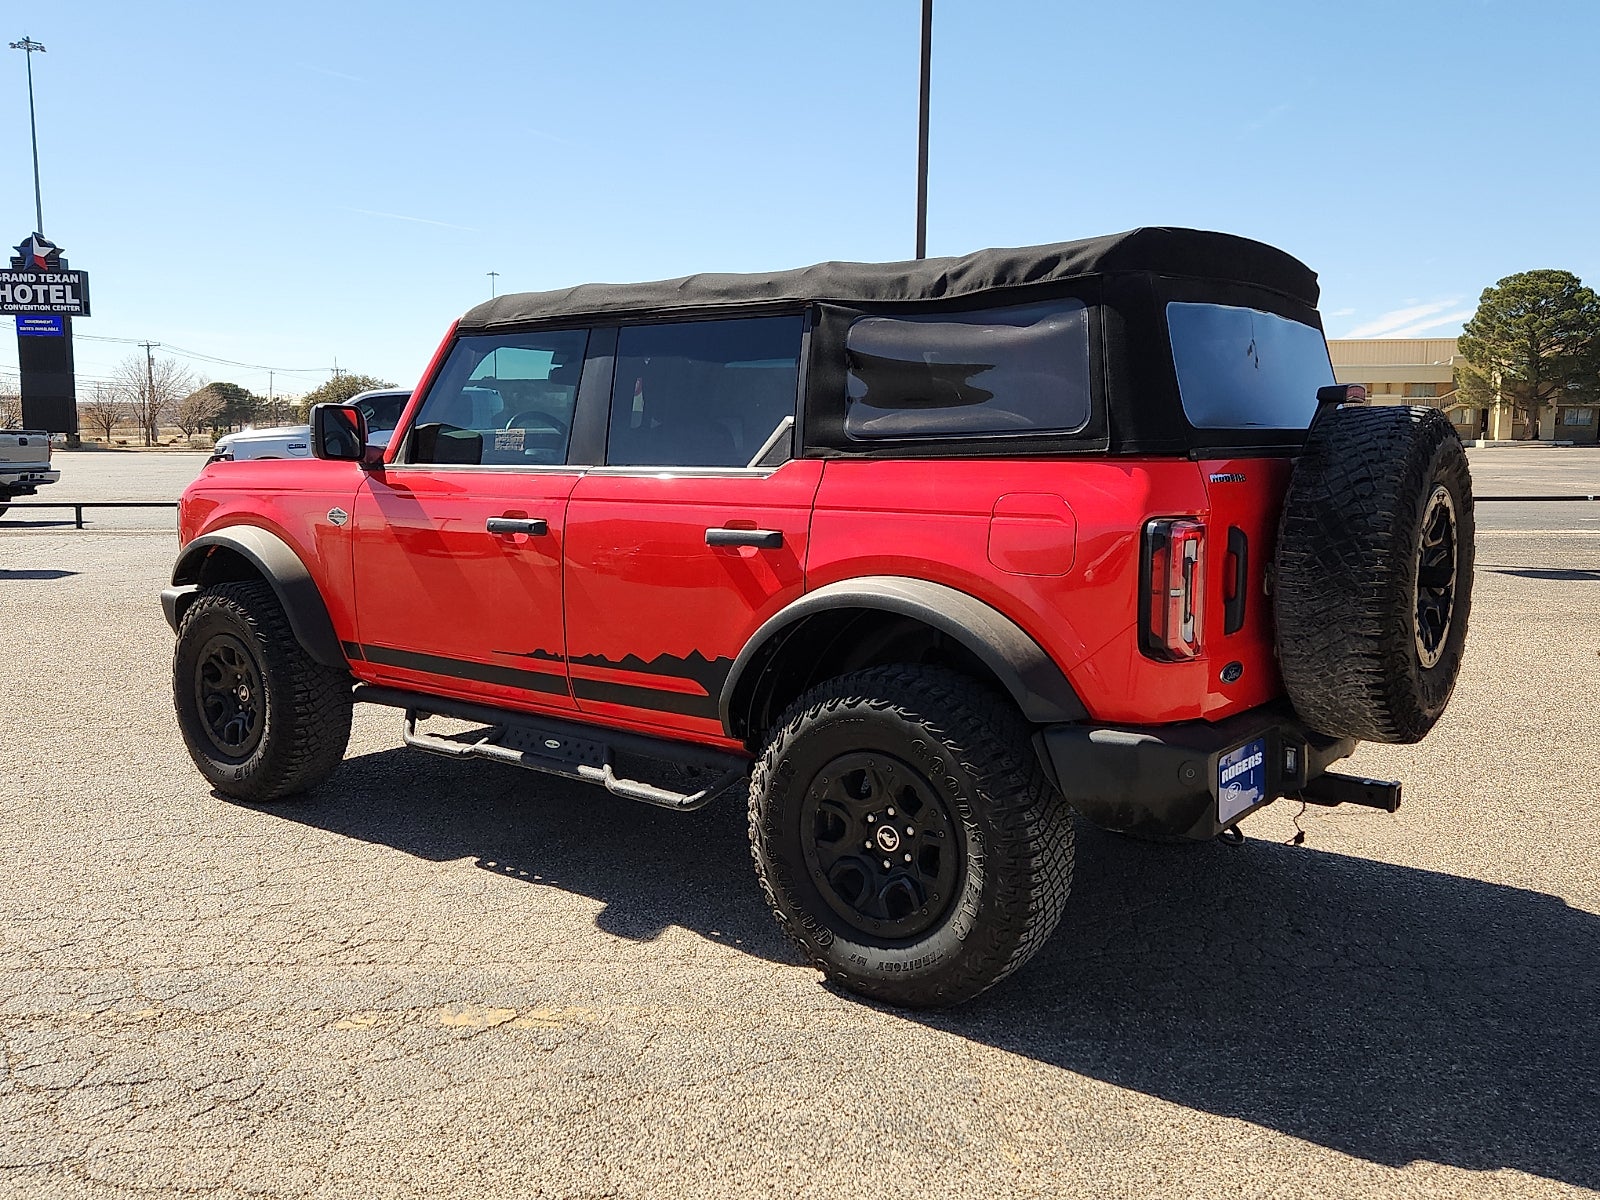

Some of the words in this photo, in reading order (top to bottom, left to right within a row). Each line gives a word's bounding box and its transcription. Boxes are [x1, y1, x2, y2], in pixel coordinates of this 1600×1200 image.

[0, 272, 36, 283] RAND
[38, 273, 79, 283] TEXAN
[0, 283, 80, 304] HOTEL
[4, 303, 51, 311] CONVENTION
[52, 304, 80, 312] CENTER
[1221, 751, 1263, 784] ROGERS
[848, 952, 868, 966] MT
[876, 950, 944, 971] TERRITORY
